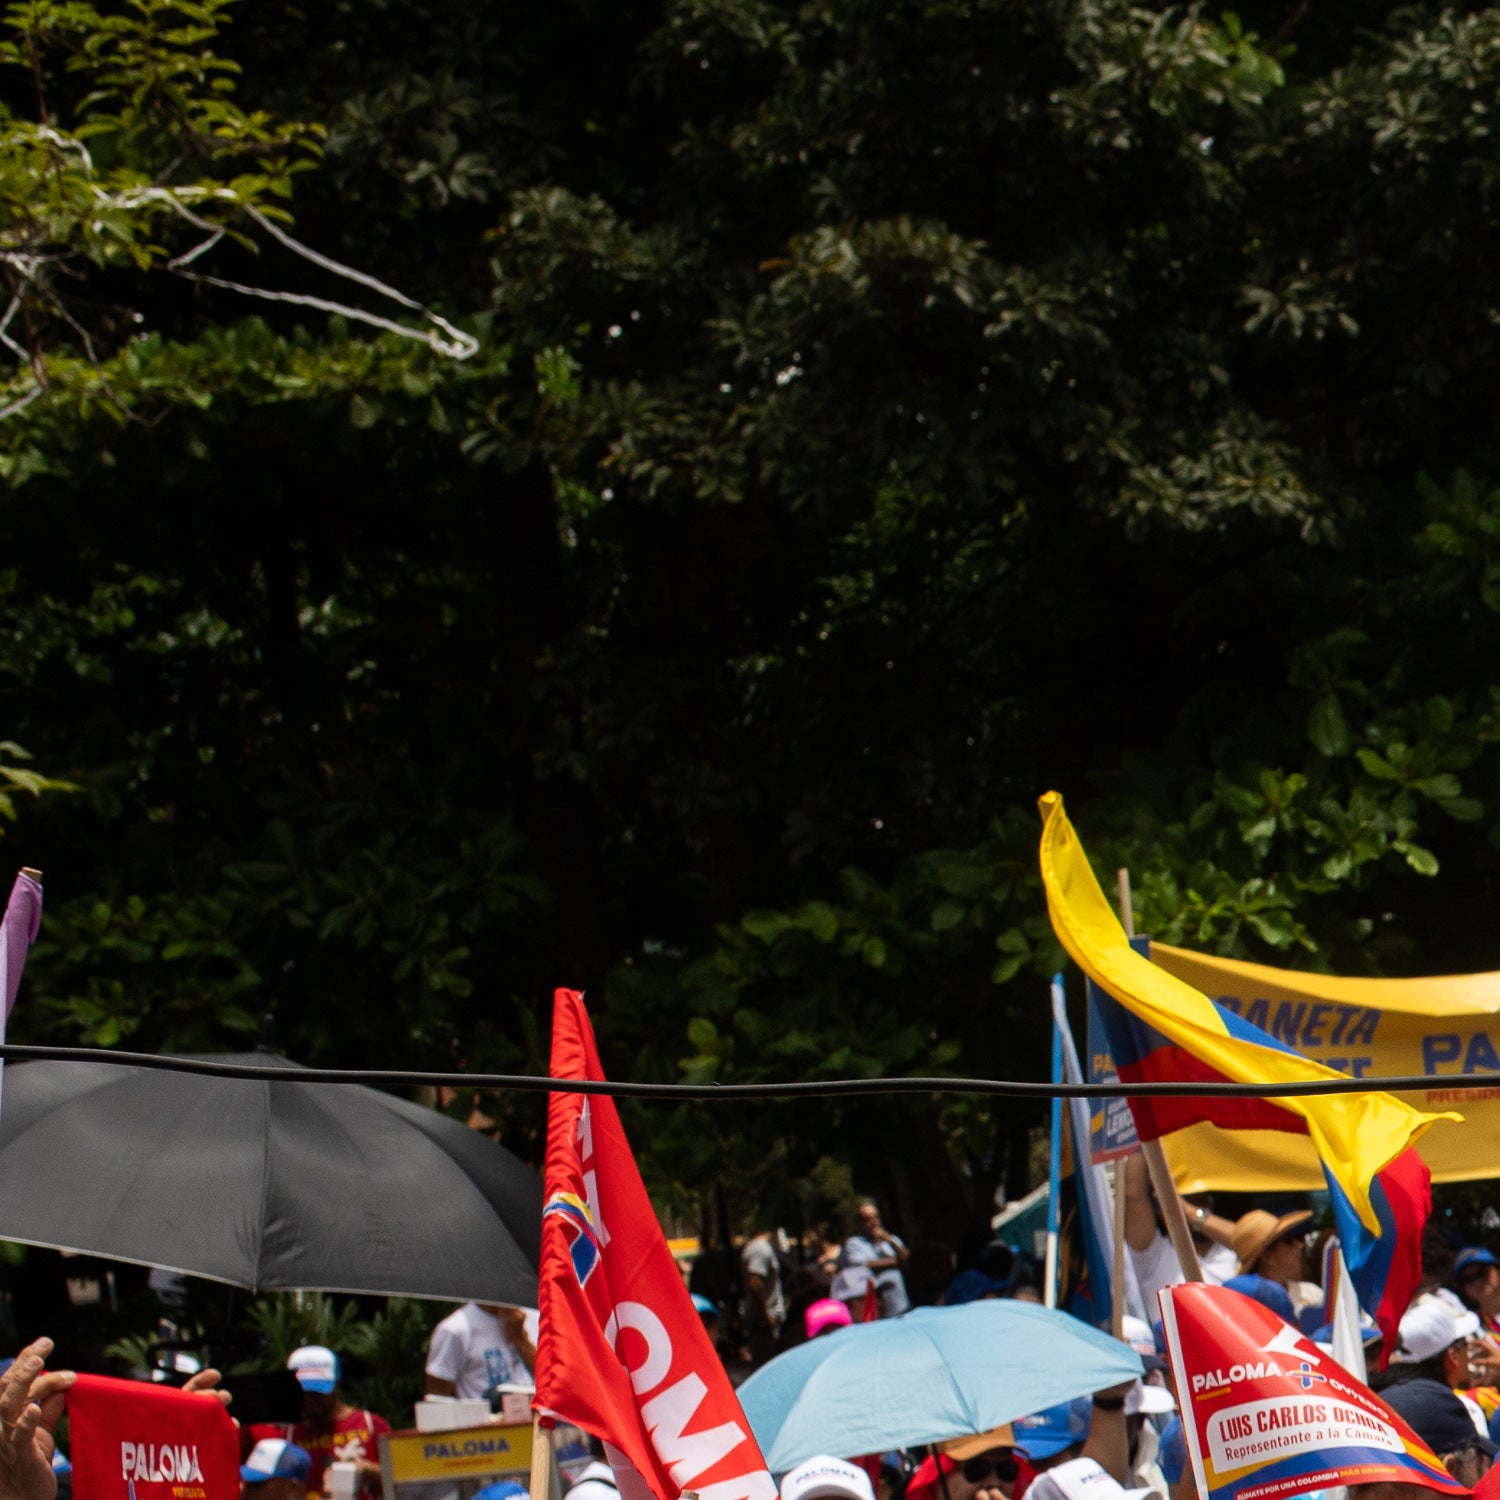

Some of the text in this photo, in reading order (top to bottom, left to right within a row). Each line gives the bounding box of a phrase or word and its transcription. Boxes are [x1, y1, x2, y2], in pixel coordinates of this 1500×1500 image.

[1192, 1361, 1282, 1393] PALOMA
[1219, 1405, 1388, 1443] LUIS CARLOS OCHOA
[423, 1438, 511, 1459] PALOMA
[1225, 1432, 1311, 1461] Representante
[1316, 1430, 1323, 1440] a
[1328, 1427, 1340, 1438] la
[121, 1441, 204, 1483] PALOMA
[1264, 1483, 1279, 1495] POR
[1280, 1480, 1296, 1492] UNA
[1297, 1472, 1339, 1488] COLOMBIA
